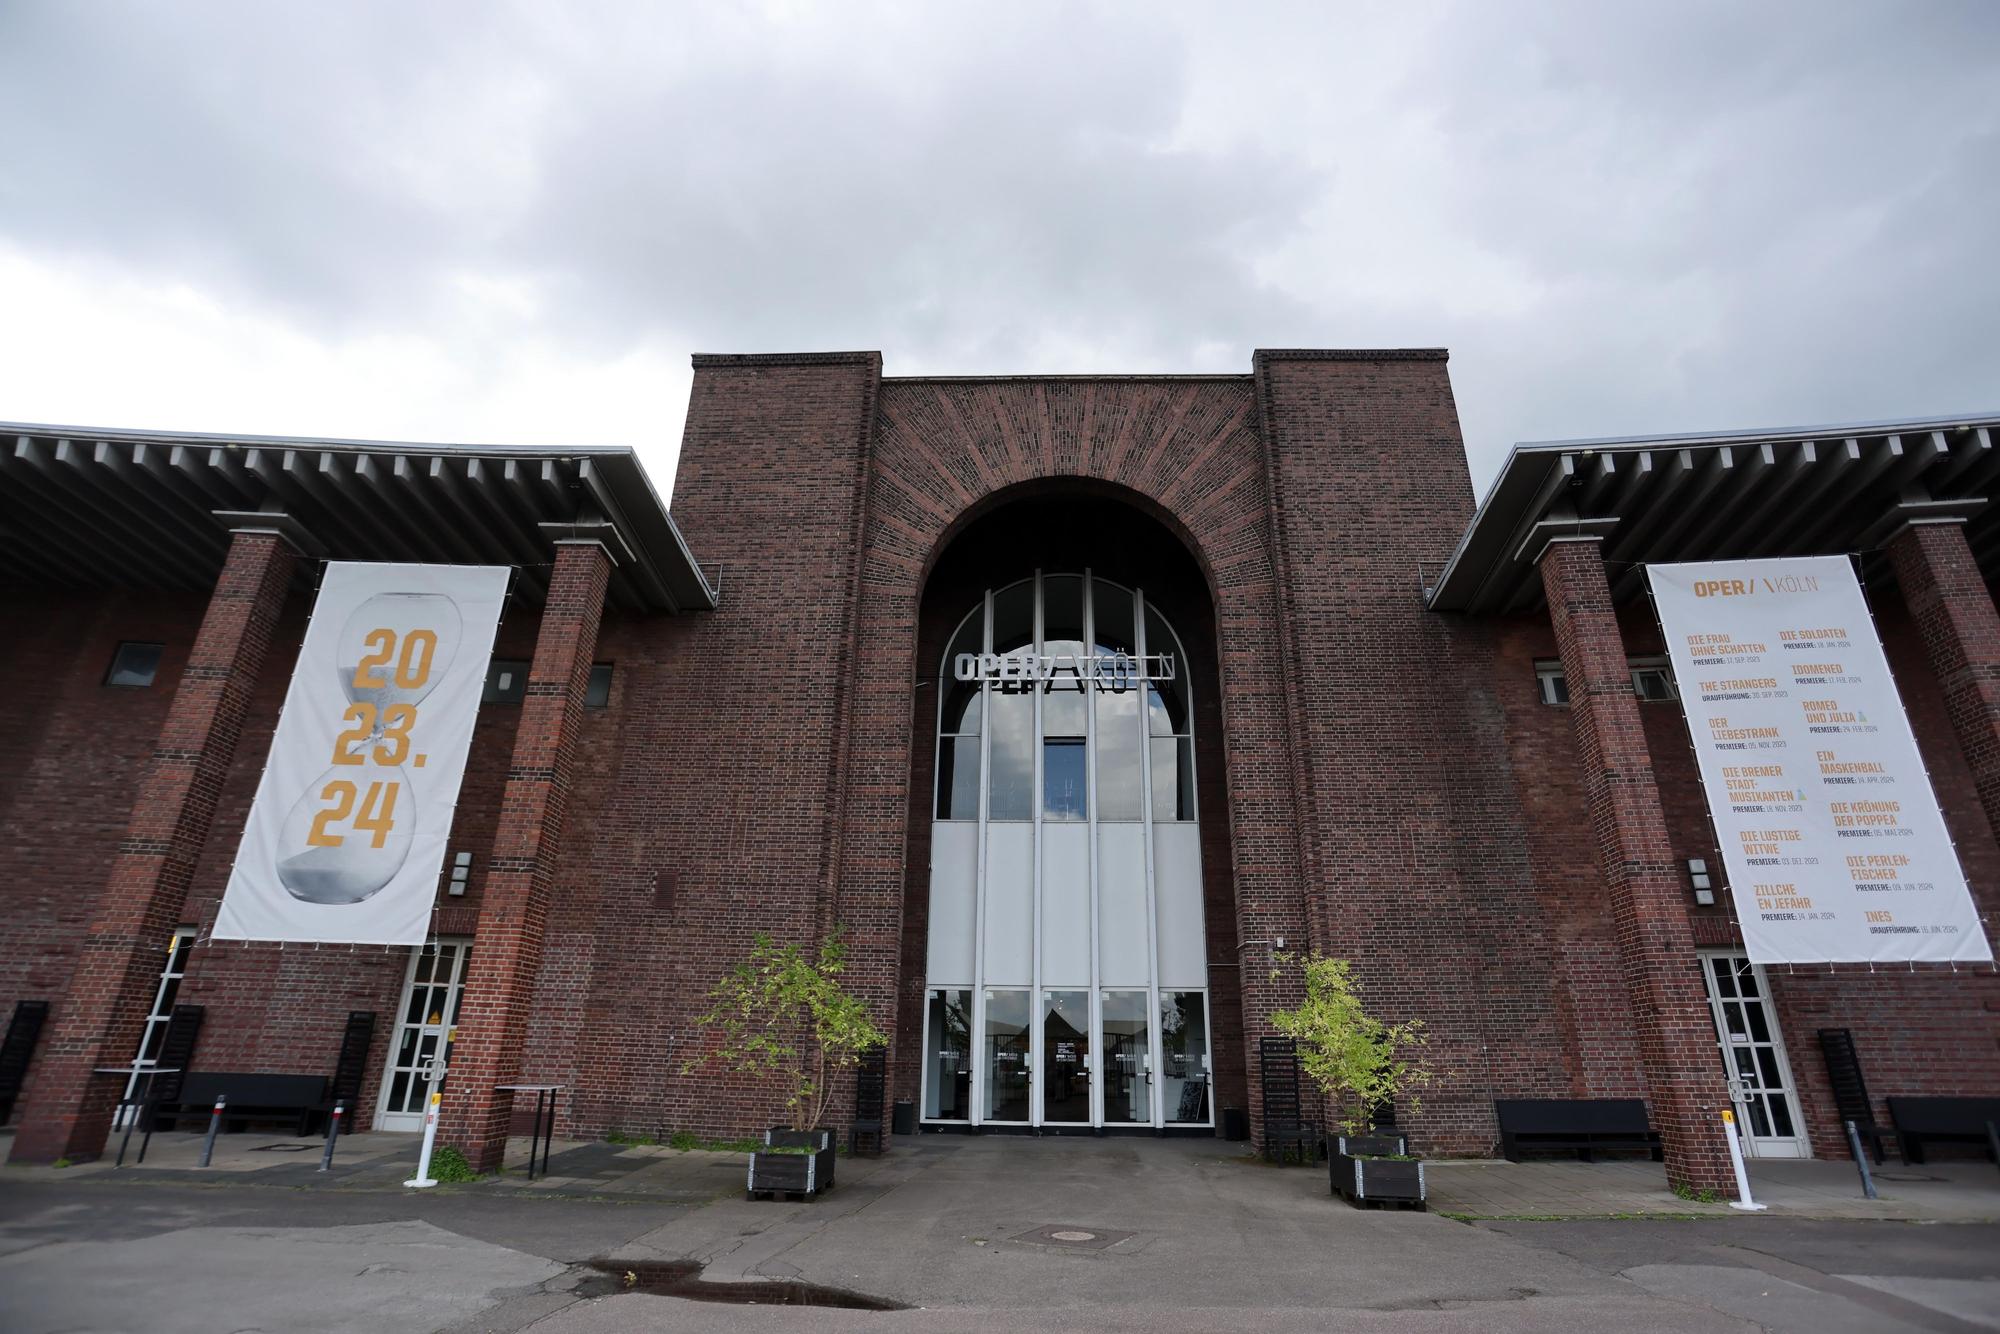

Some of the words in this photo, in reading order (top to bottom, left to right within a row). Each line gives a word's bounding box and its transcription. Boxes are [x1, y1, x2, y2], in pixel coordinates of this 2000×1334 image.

[1687, 635, 1705, 645] DIE
[1706, 634, 1731, 644] FRAU
[1780, 631, 1798, 640] DIE
[1799, 628, 1847, 640] SOLDATEN
[1690, 646, 1717, 656] OHNE
[1718, 644, 1766, 655] SCHATTEN
[1783, 642, 1816, 650] PREMIERE:
[352, 628, 437, 689] 20
[1693, 658, 1726, 666] PREMIERE:
[1792, 664, 1843, 675] IDOMENEO
[1699, 681, 1718, 692] THE
[1720, 678, 1777, 691] STRANGERS
[1795, 677, 1828, 685] PREMIERE:
[1702, 692, 1751, 702] URAUFFÜHRUNG:
[1802, 700, 1838, 711] ROMEO
[1709, 718, 1728, 728] DER
[1806, 713, 1827, 723] UND
[1829, 712, 1856, 723] JULIA
[331, 702, 428, 767] 23.
[1712, 728, 1779, 740] LIEBESTRANK
[1810, 726, 1842, 734] PREMIERE:
[1817, 751, 1835, 761] EIN
[1722, 767, 1740, 778] DIE
[1741, 766, 1783, 777] BREMER
[1820, 762, 1885, 774] MASKENBALL
[1726, 779, 1758, 790] STADT-
[1824, 777, 1857, 785] PREMIERE:
[1728, 790, 1794, 802] MUSIKANTEN
[1732, 805, 1766, 813] PREMIERE:
[1830, 802, 1848, 813] DIE
[1850, 800, 1900, 813] KRÖNUNG
[306, 780, 399, 848] 24
[1834, 816, 1854, 826] DER
[1856, 814, 1898, 826] POPPEA
[1740, 831, 1758, 842] DIE
[1760, 830, 1802, 841] LUSTIGE
[1838, 830, 1873, 838] PREMIERE:
[1742, 844, 1780, 855] WITWE
[1746, 858, 1781, 866] PREMIERE:
[1846, 856, 1866, 867] DIE
[1867, 855, 1910, 866] PERLEN-
[1851, 868, 1897, 880] FISCHER
[1754, 884, 1796, 896] ZILLCHE
[1856, 884, 1892, 892] PREMIERE:
[1758, 898, 1772, 910] EN
[1774, 897, 1812, 910] JEFAHR
[1761, 913, 1797, 921] PREMIERE:
[1864, 911, 1892, 923] INES
[1870, 925, 1920, 934] URAUFFÜHRUNG:
